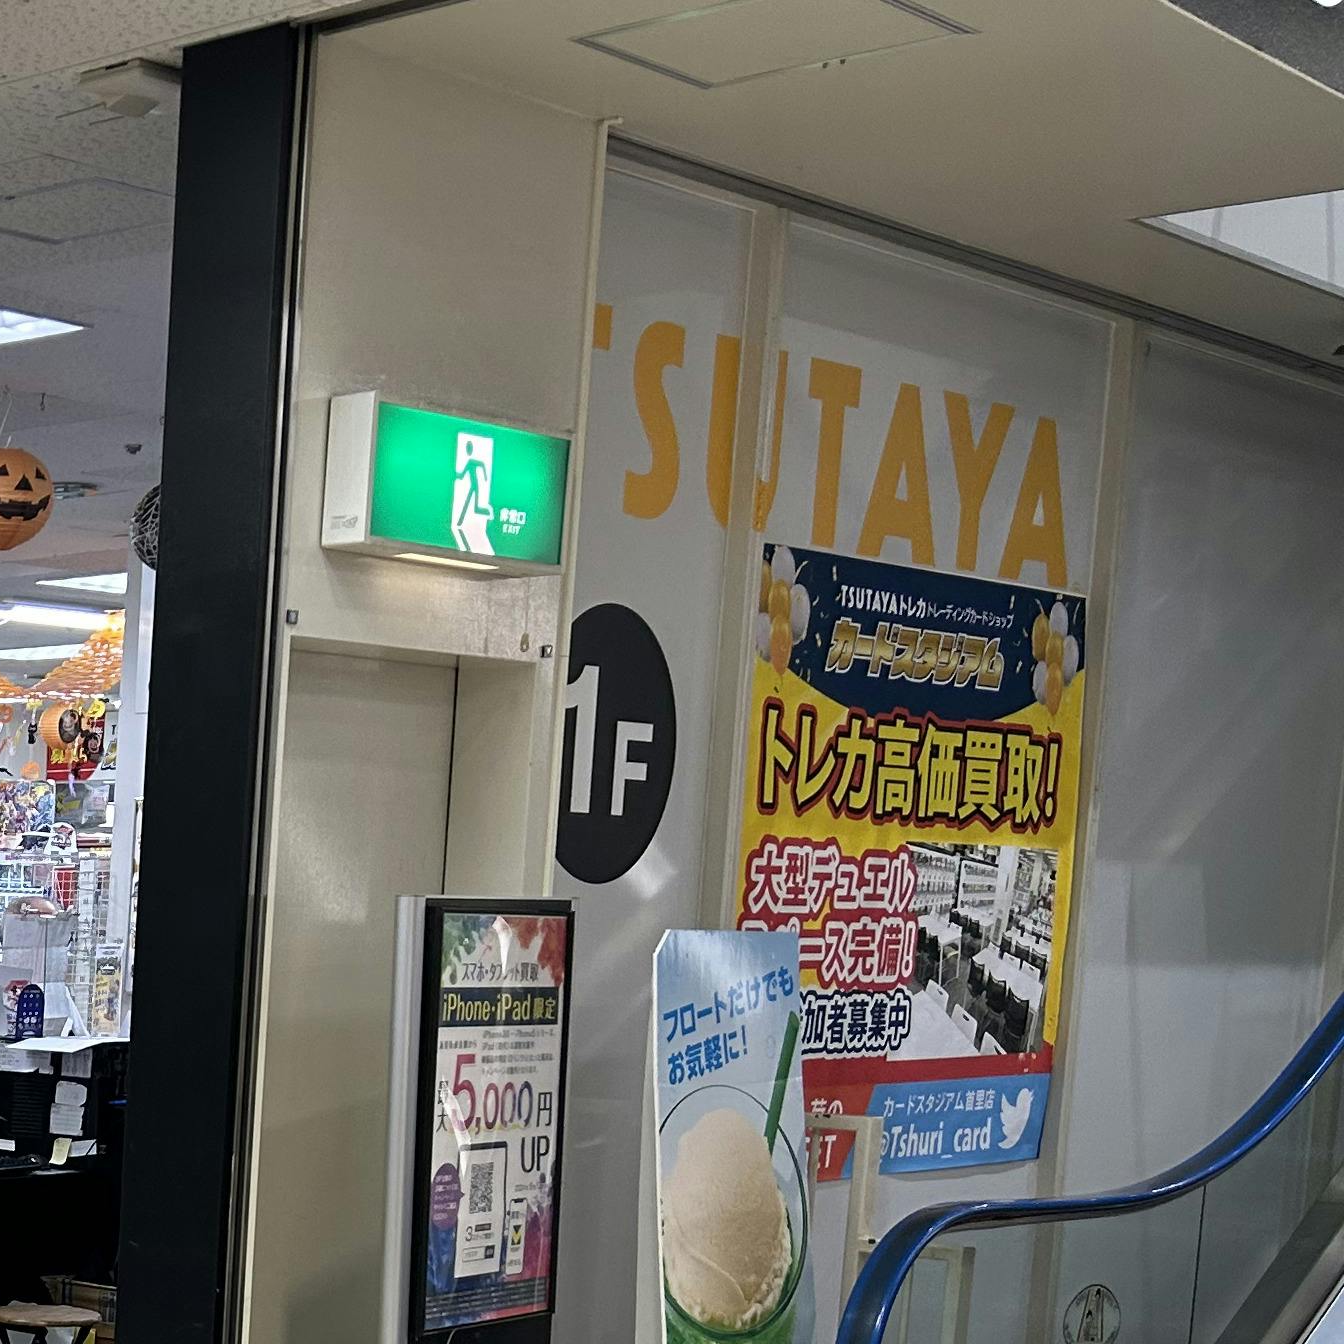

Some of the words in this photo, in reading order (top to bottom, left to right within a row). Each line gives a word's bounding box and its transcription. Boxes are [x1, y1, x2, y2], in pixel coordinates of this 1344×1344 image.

[593, 304, 1068, 588] SUTAYA
[825, 616, 1005, 692] カードスタジアム
[564, 664, 655, 818] 1F
[761, 706, 1060, 826] トレカ高価買取!
[748, 842, 916, 914] 大型デュエル
[663, 966, 794, 1043] フロートだけでも
[799, 992, 911, 1052] 加者募集中
[667, 1024, 748, 1086] お気軽に!
[883, 1087, 994, 1118] カードスタジアム首里店
[520, 1135, 551, 1174] UP
